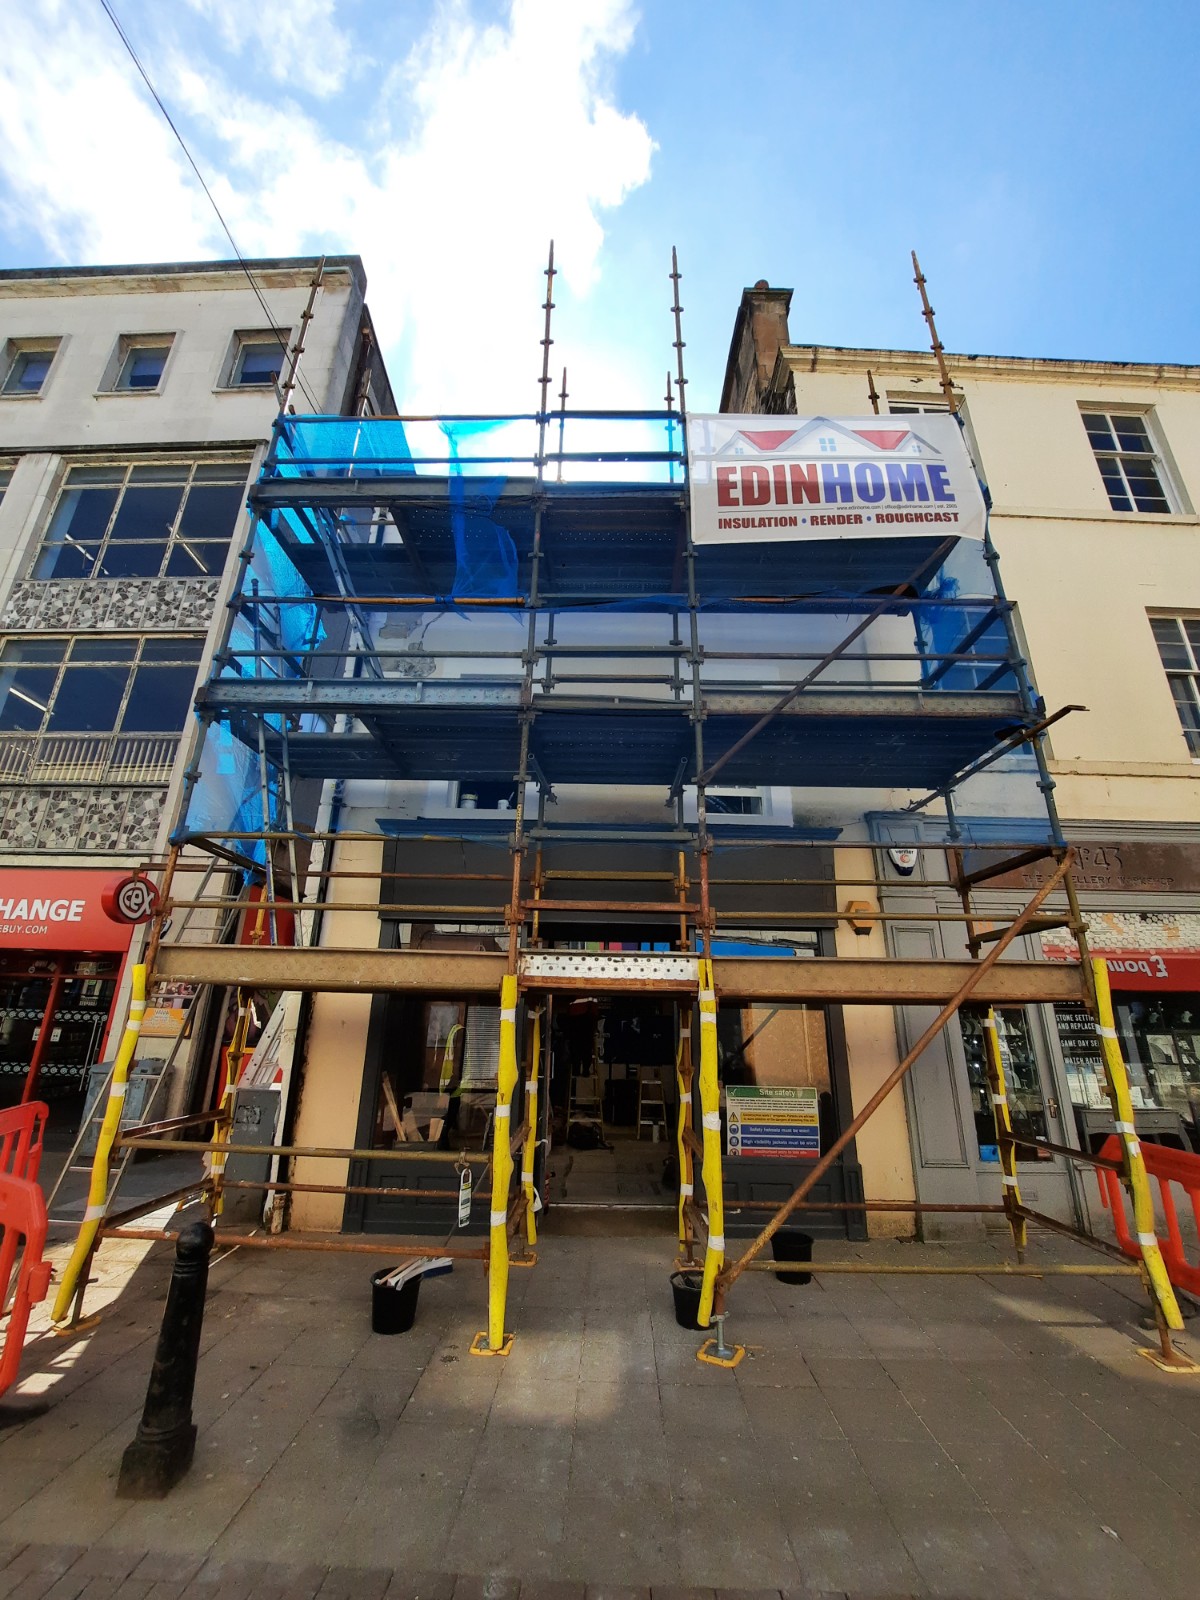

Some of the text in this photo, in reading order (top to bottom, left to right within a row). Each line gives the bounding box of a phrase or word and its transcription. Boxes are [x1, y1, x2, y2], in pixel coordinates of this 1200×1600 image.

[716, 462, 956, 507] EDINHOME
[718, 512, 959, 529] INSULATION RENDER ROUGHCAST
[1056, 1014, 1074, 1022] STONE
[1058, 1022, 1070, 1030] AND
[1061, 1039, 1077, 1047] SAME
[1077, 1039, 1089, 1047] DAY
[759, 1088, 796, 1097] Site safety
